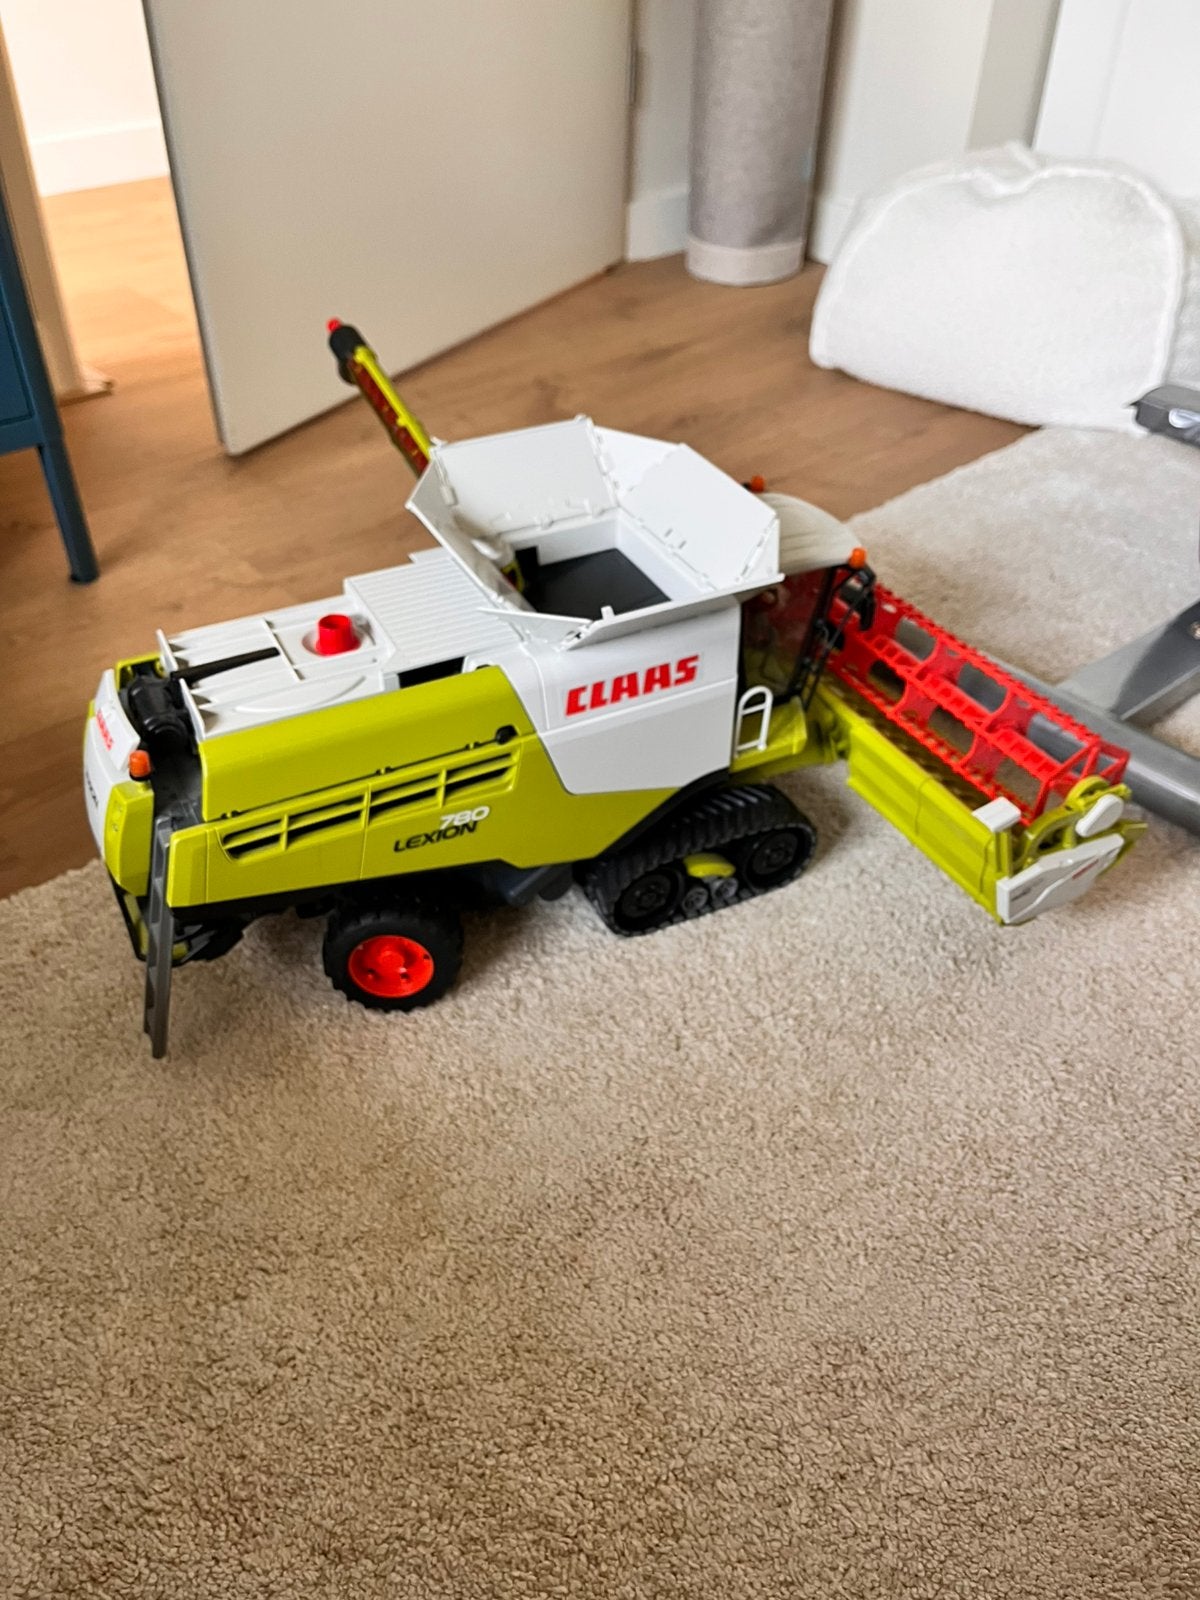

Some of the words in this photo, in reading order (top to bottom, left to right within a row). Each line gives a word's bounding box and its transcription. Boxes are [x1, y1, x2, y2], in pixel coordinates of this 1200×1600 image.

[566, 654, 699, 716] CLAAS
[440, 805, 490, 830] 780
[393, 820, 478, 853] LEXION
